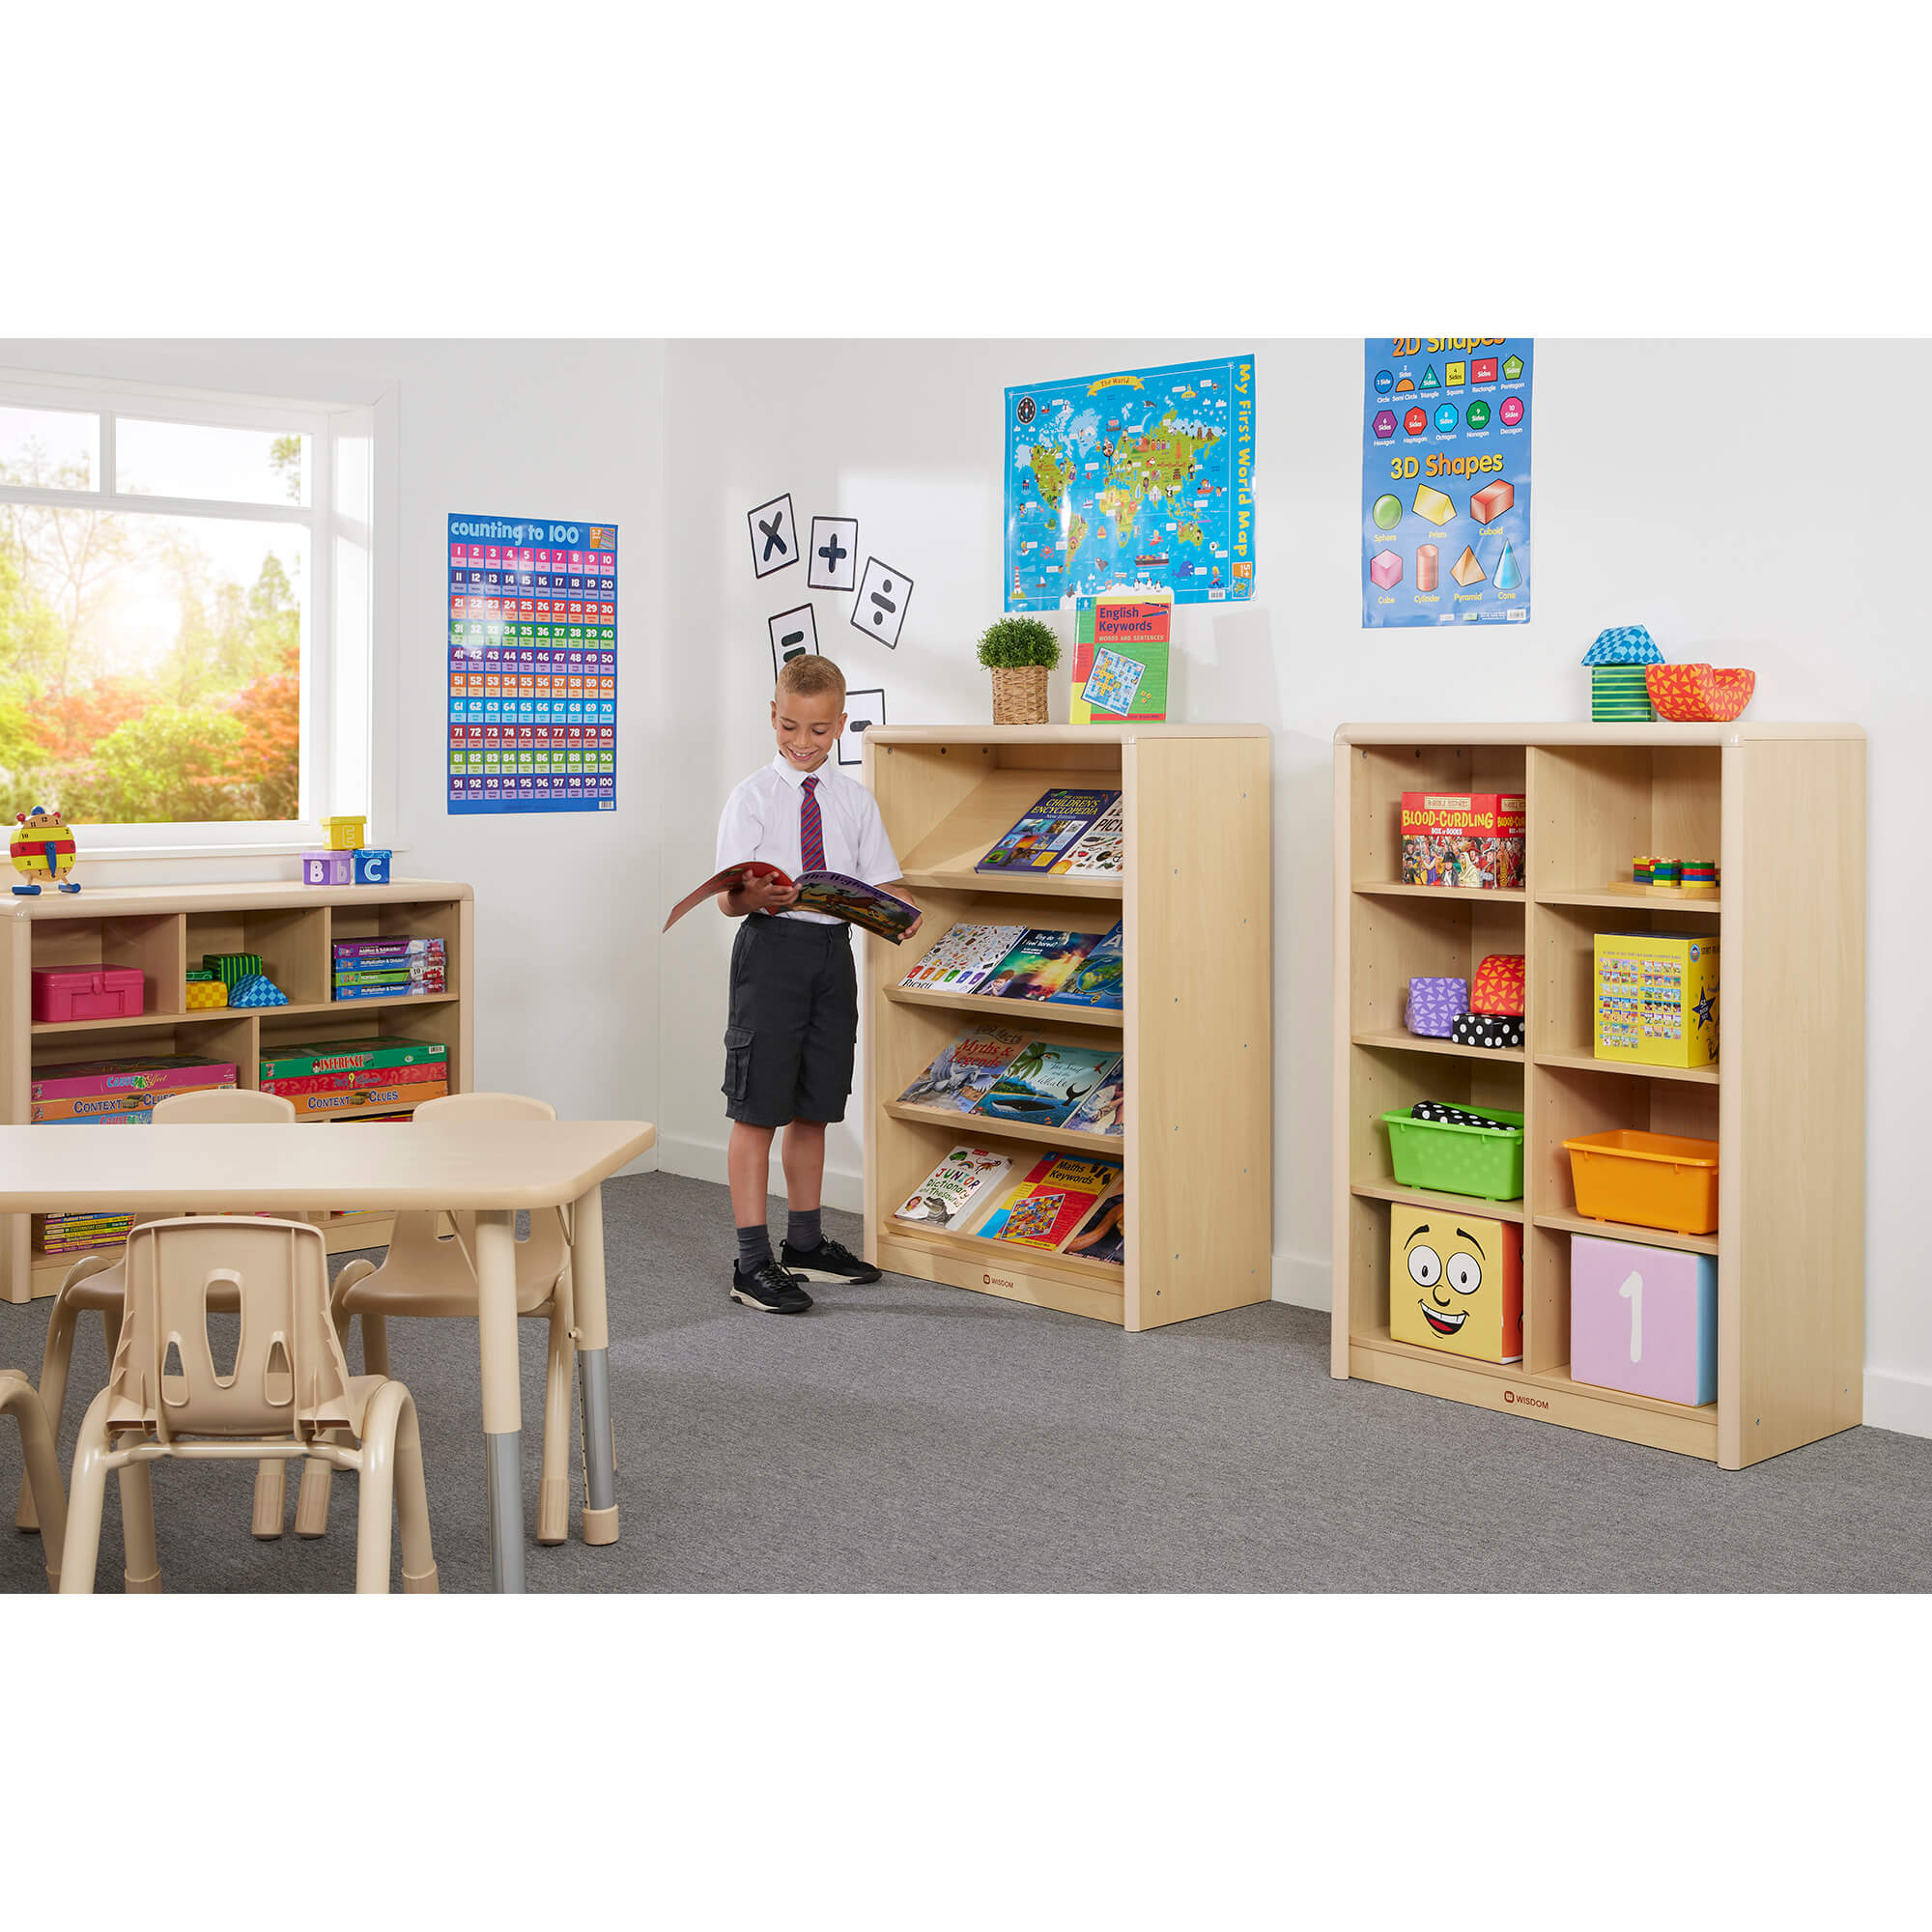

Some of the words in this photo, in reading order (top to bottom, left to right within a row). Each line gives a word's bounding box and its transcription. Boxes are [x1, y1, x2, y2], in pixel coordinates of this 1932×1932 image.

[1392, 338, 1421, 357] 2D
[1235, 364, 1251, 394] My
[1501, 382, 1525, 390] Pentagon
[1472, 385, 1496, 393] Rectangle
[1238, 400, 1251, 443] First
[1391, 456, 1419, 480] 3D
[1425, 452, 1504, 480] Shapes
[1238, 448, 1251, 505] World
[451, 522, 523, 546] counting
[528, 526, 544, 540] to
[549, 525, 579, 544] 100
[1233, 511, 1251, 557] Map
[1479, 527, 1503, 536] Cuboid
[472, 573, 480, 582] 12
[489, 574, 497, 583] 13
[505, 575, 514, 584] 14
[539, 577, 547, 586] 16
[555, 578, 563, 586] 17
[571, 578, 580, 587] 18
[587, 579, 596, 588] 19
[601, 580, 613, 589] 20
[1414, 595, 1440, 603] Cylinder
[1454, 593, 1482, 603] Pyramid
[1100, 608, 1139, 620] English
[1099, 621, 1152, 634] Keywords
[454, 676, 463, 685] 51
[470, 676, 482, 685] 52
[487, 676, 499, 686] 53
[504, 677, 516, 686] 54
[521, 677, 532, 686] 55
[537, 677, 549, 687] 56
[554, 678, 565, 687] 57
[570, 678, 581, 687] 58
[586, 679, 597, 687] 59
[601, 679, 613, 688] 60
[454, 728, 463, 736] 71
[470, 727, 481, 736] 72
[487, 728, 498, 737] 73
[504, 728, 514, 736] 74
[520, 728, 531, 737] 75
[537, 728, 548, 737] 76
[553, 728, 564, 737] 77
[569, 728, 580, 737] 78
[585, 728, 596, 737] 79
[601, 728, 612, 737] 80
[454, 779, 463, 788] 91
[470, 779, 481, 788] 92
[486, 779, 498, 788] 93
[503, 779, 515, 787] 94
[520, 778, 532, 787] 95
[537, 779, 548, 787] 96
[553, 778, 564, 787] 97
[569, 778, 581, 787] 98
[585, 778, 596, 786] 99
[600, 778, 613, 786] 100
[1030, 806, 1098, 815] ENCYCLOPEDIA
[1402, 810, 1493, 829] BLOOD-CURDLING
[342, 825, 356, 848] E
[310, 860, 324, 882] B
[364, 858, 382, 881] C
[958, 1039, 1000, 1055] Myths
[1000, 1047, 1014, 1056] &
[320, 1054, 364, 1071] INFERENCE
[950, 1051, 1001, 1068] Legends
[107, 1076, 135, 1088] CAUSE
[144, 1073, 169, 1088] Effect
[74, 1100, 122, 1113] CONTEXT
[308, 1096, 350, 1109] CONTEXT
[369, 1090, 398, 1102] CLUES
[1057, 1160, 1085, 1173] Maths
[935, 1167, 981, 1190] JUNIOR
[1049, 1169, 1095, 1185] Keywords
[926, 1178, 970, 1199] Dictionary
[928, 1186, 964, 1208] Thesaurus
[991, 1277, 1014, 1289] WISDOM
[1619, 1271, 1643, 1363] 1
[1516, 1395, 1549, 1410] WISDOM
